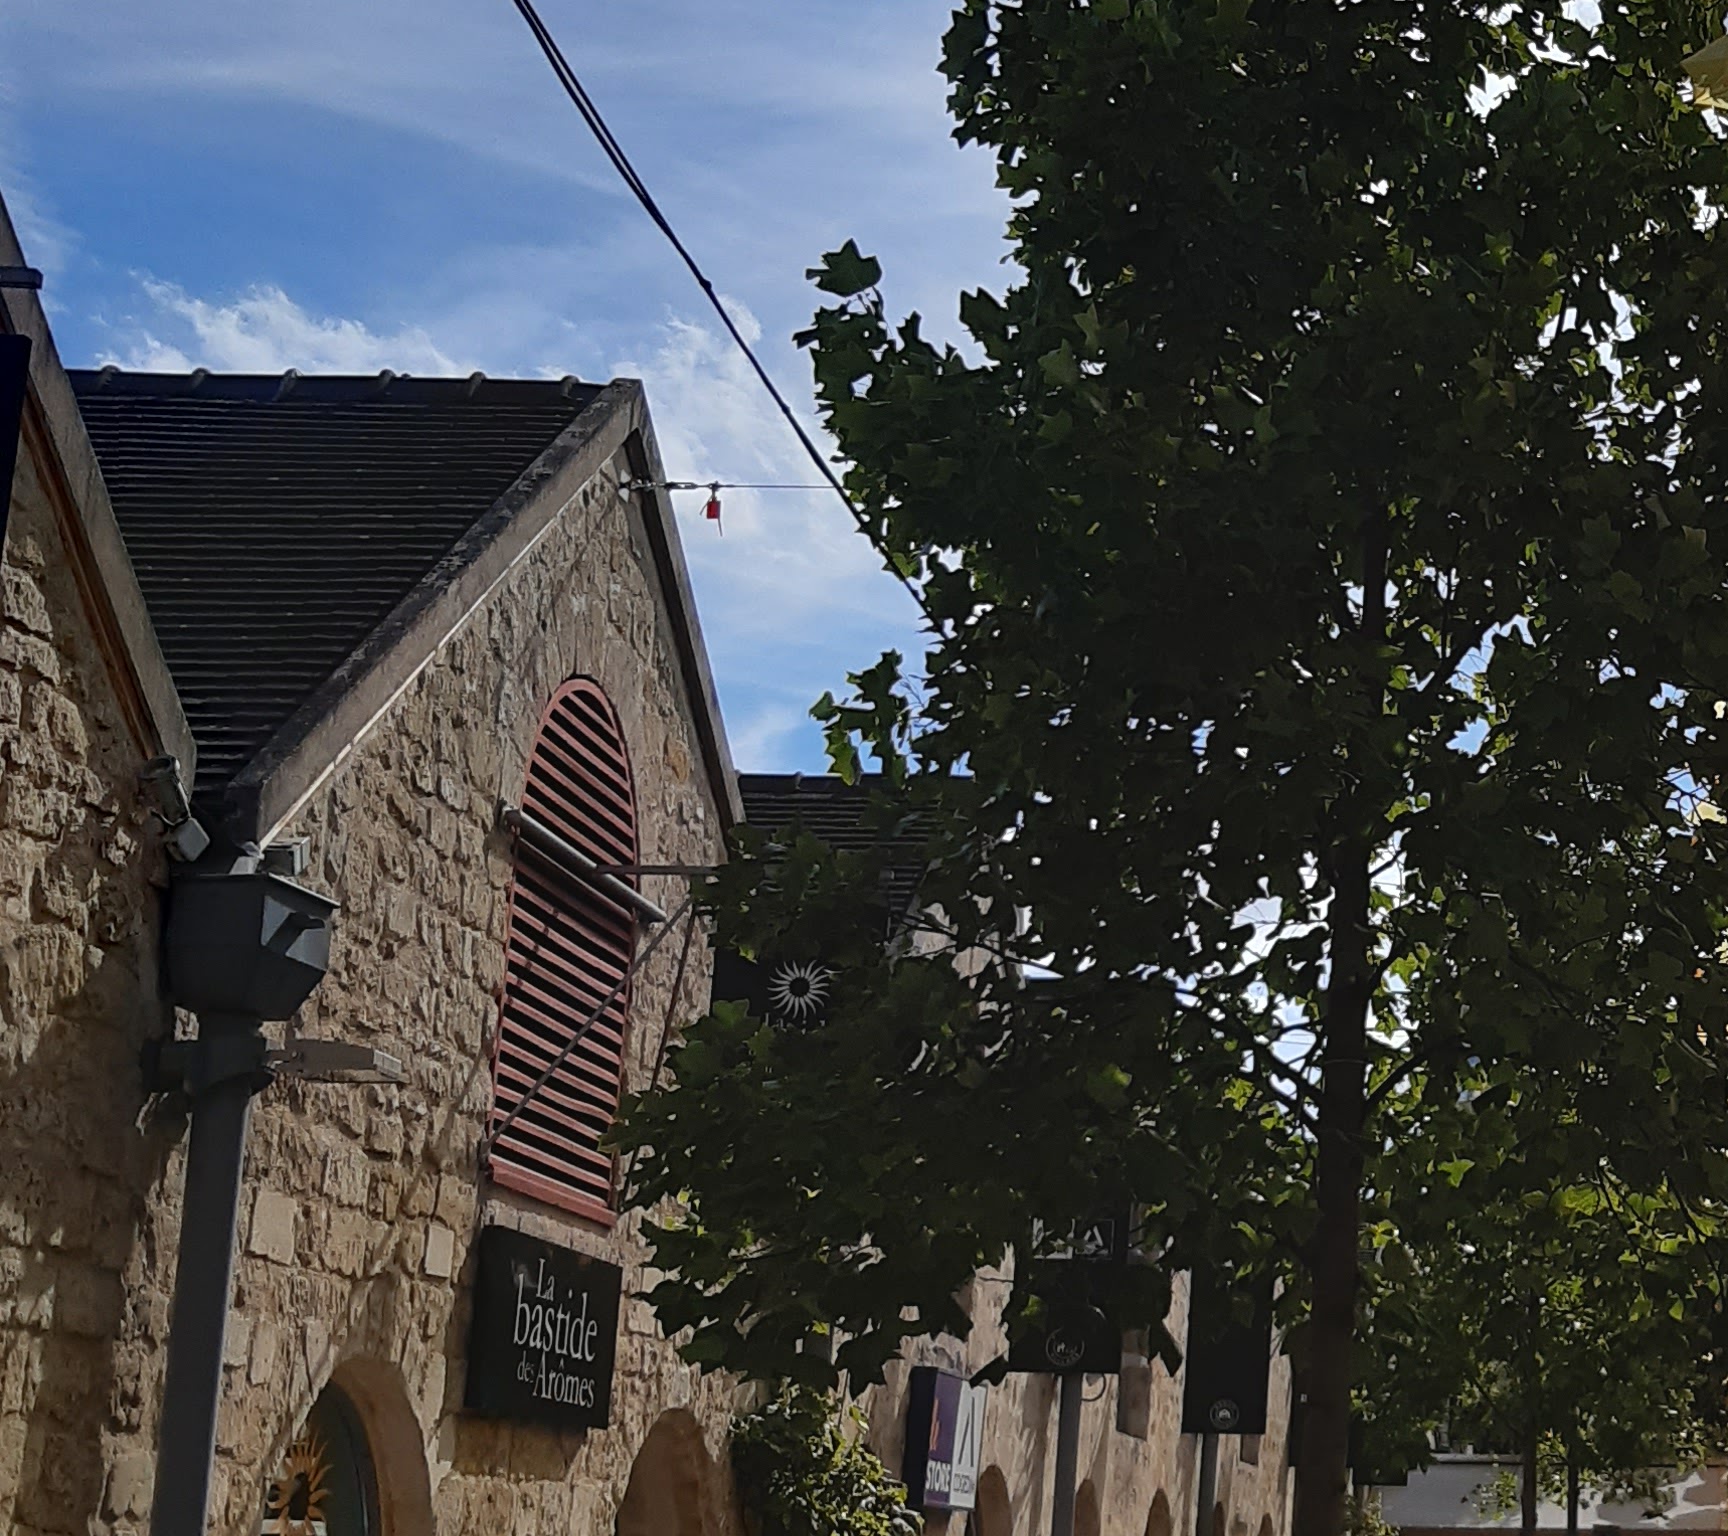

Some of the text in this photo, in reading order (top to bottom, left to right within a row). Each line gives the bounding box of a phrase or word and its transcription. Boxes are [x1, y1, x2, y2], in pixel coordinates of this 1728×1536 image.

[536, 1258, 555, 1301] La
[513, 1273, 598, 1362] bastide
[532, 1351, 595, 1408] Arômes
